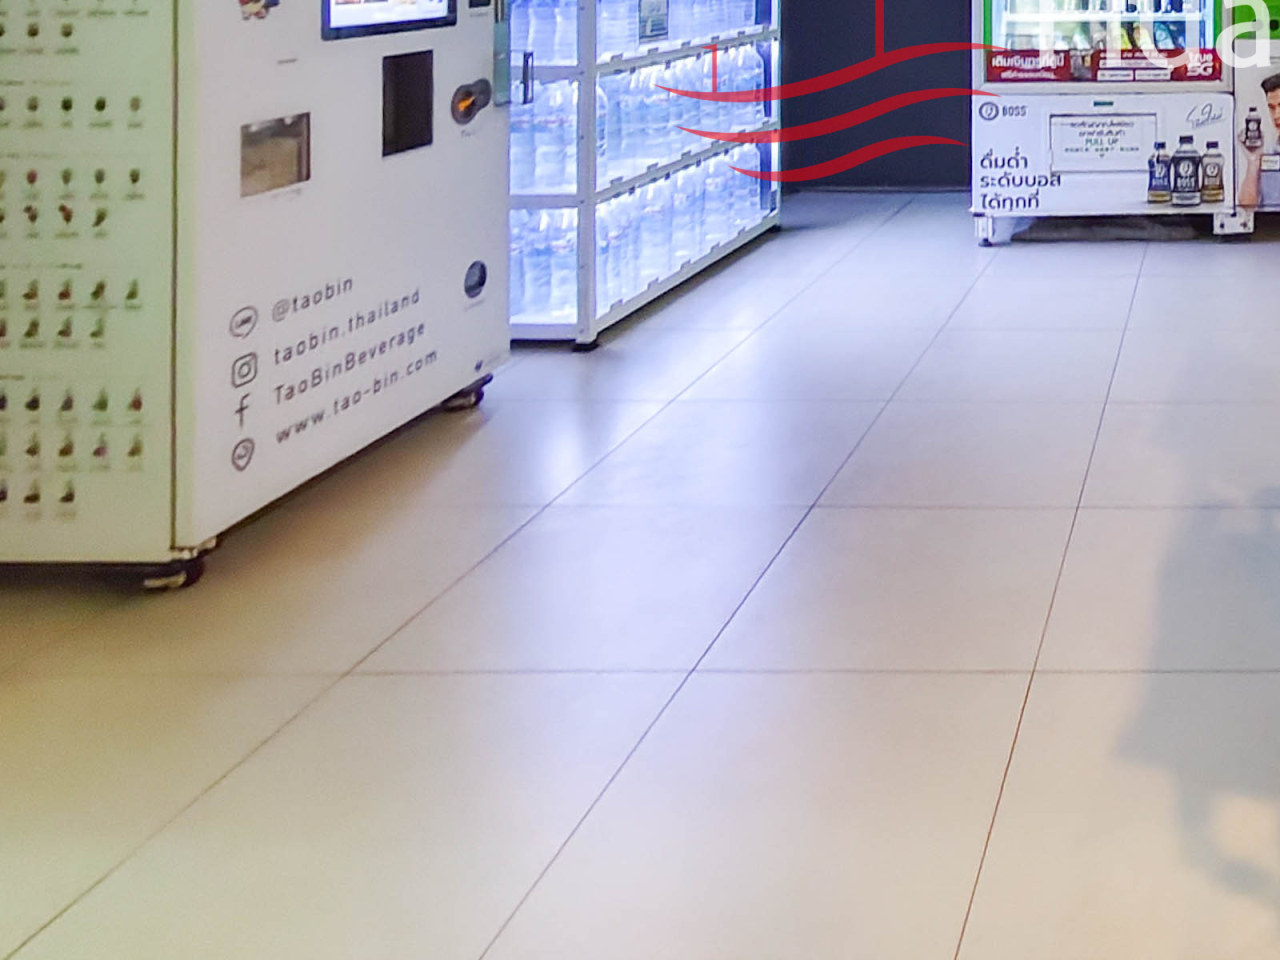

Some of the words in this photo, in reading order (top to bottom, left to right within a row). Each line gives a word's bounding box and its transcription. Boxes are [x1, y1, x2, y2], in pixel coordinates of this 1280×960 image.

[1002, 105, 1027, 117] BOSS
[980, 146, 1028, 169] ดื่มด่ำ
[980, 171, 1061, 188] ระดับบอส
[981, 188, 1039, 212] ได้ทุกที่
[271, 276, 353, 323] @taobin
[273, 287, 420, 365] taobin.thailand
[274, 321, 425, 405] TaoBinBeverage
[275, 349, 438, 444] www.tao-bin.com
